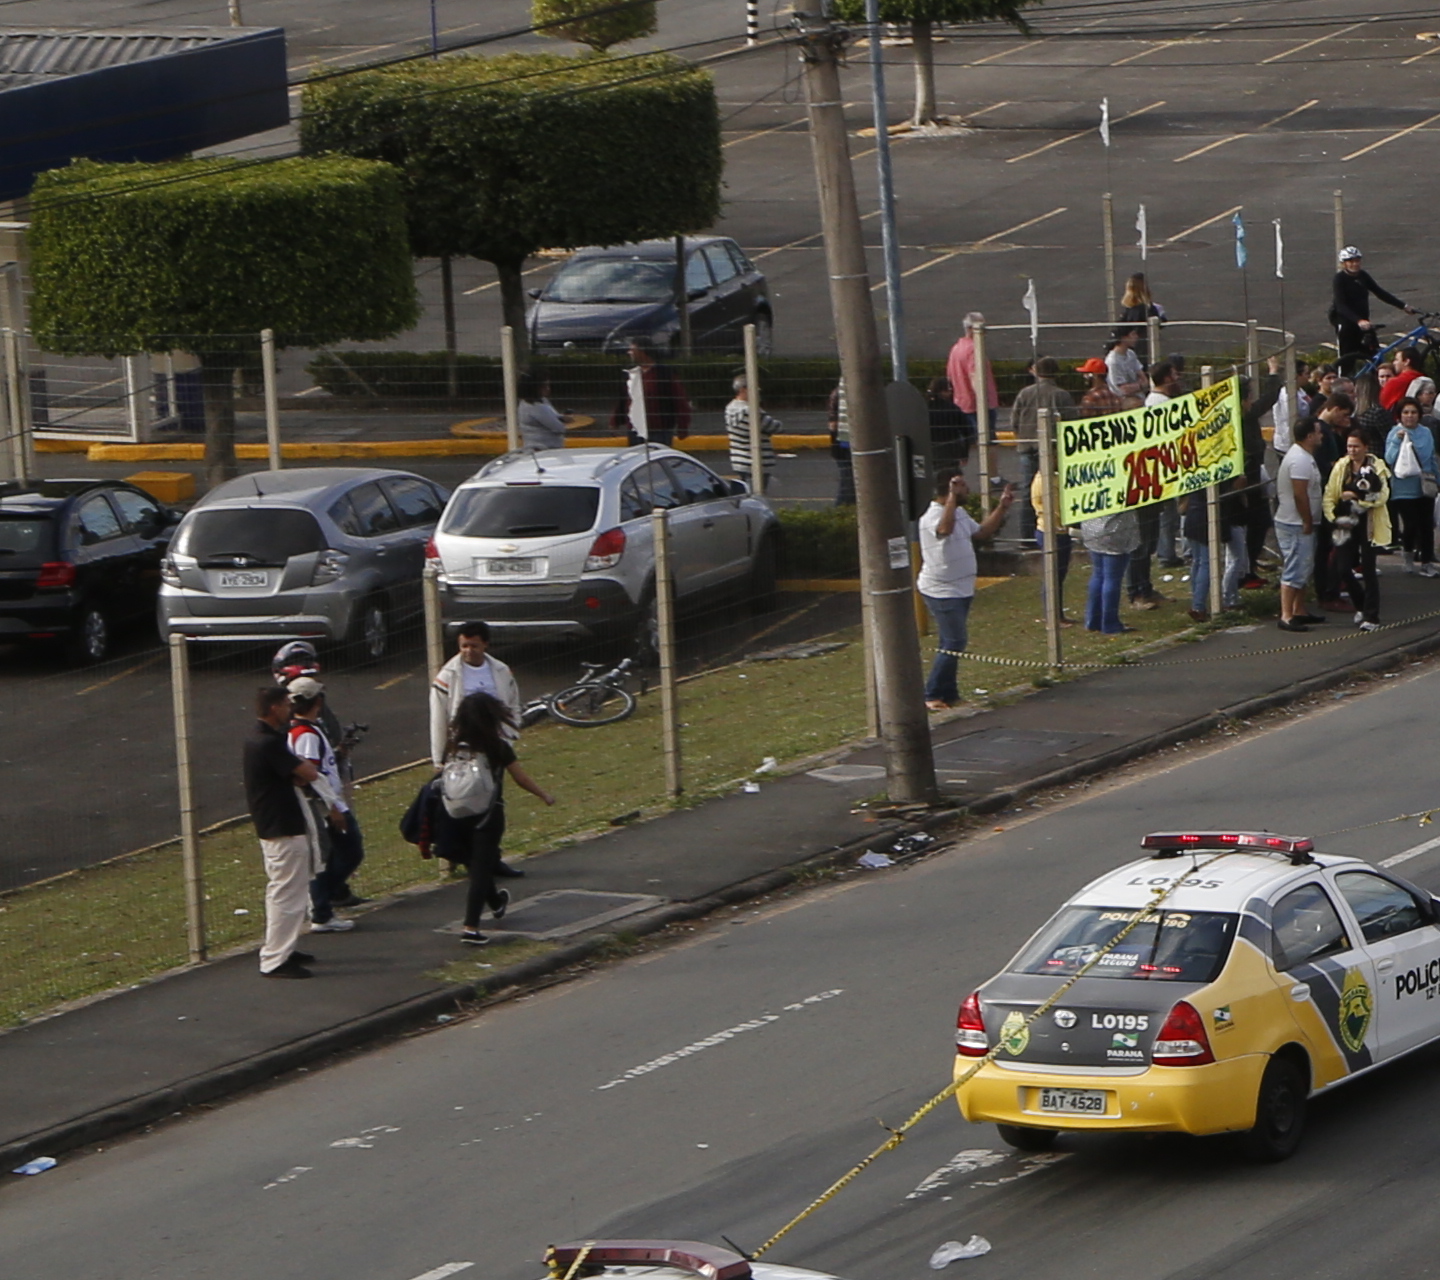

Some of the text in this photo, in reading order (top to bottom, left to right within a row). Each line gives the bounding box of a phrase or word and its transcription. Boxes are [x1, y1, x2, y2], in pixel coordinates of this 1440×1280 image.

[1064, 399, 1193, 457] DAFENIS ÓTICA
[1101, 952, 1139, 963] PARANÁ
[1097, 959, 1137, 969] SEGURO
[1106, 1049, 1144, 1059] PARANÁ
